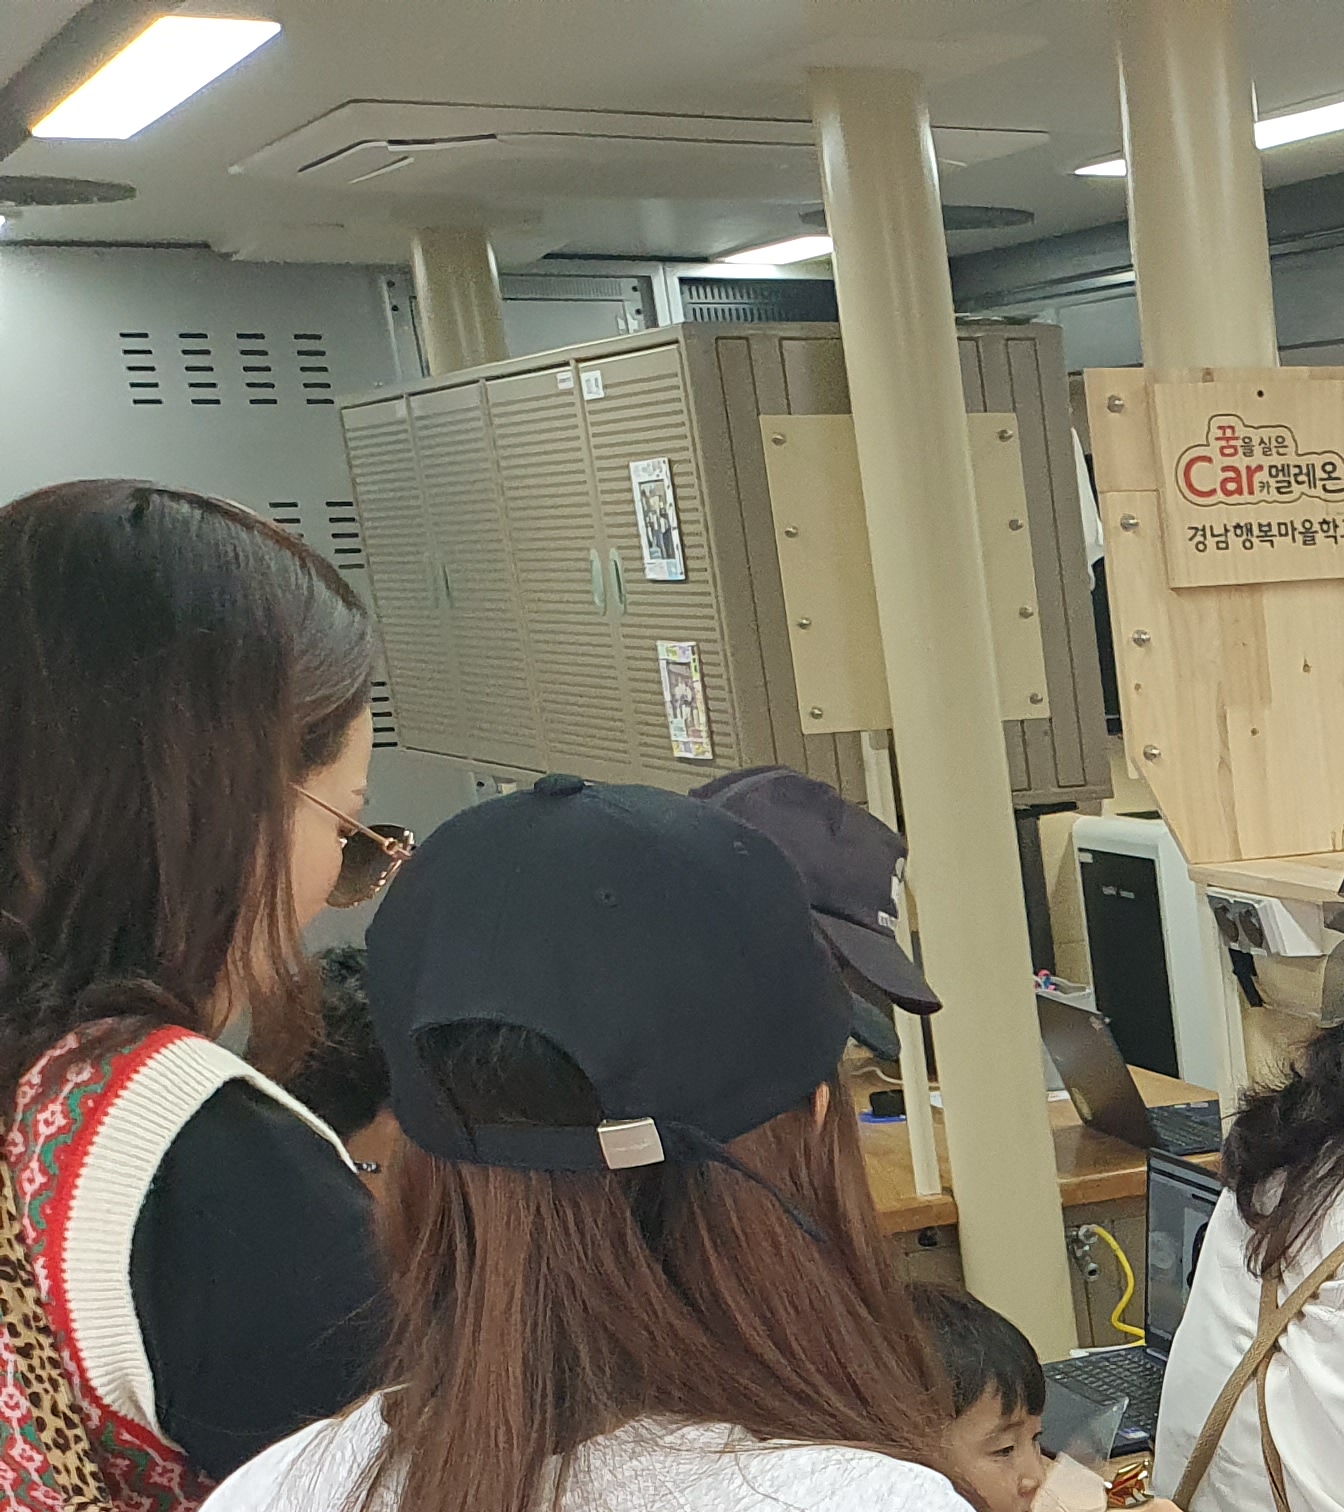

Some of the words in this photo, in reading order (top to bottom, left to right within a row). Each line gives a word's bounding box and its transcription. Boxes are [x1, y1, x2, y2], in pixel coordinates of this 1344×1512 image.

[1214, 425, 1255, 457] 꿈을
[1258, 436, 1289, 456] 실은
[1183, 455, 1263, 498] Car
